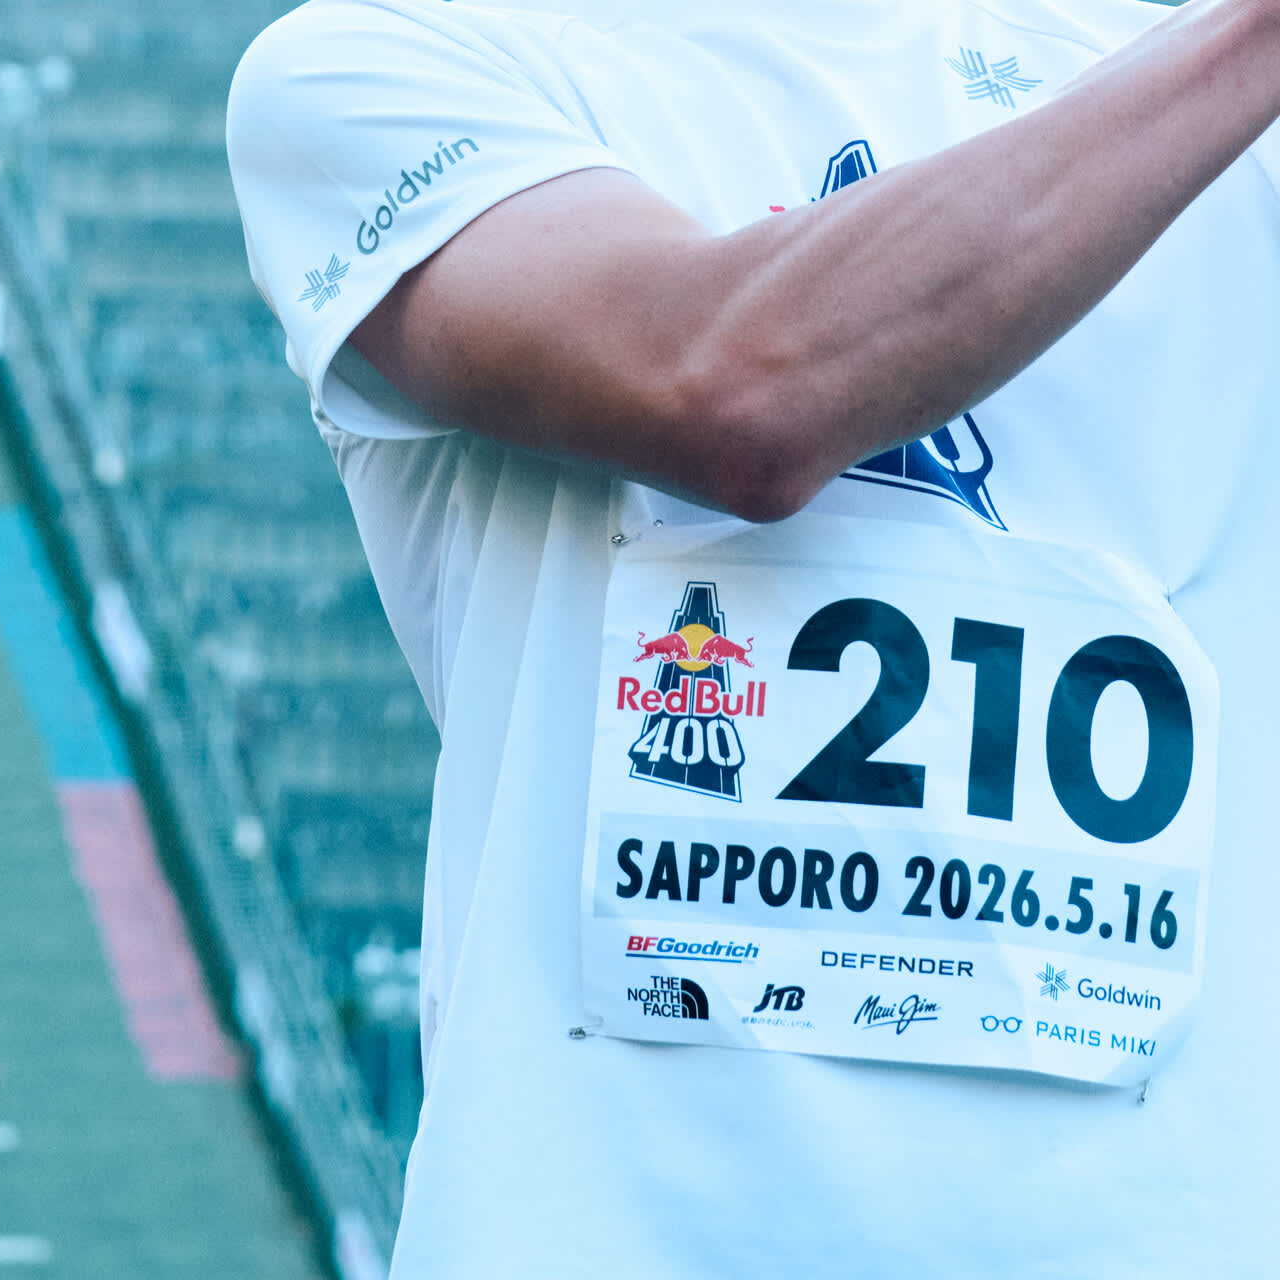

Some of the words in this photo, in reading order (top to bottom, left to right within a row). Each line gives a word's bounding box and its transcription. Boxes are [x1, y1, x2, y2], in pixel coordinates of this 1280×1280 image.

[355, 135, 480, 256] Goldwin
[616, 676, 689, 713] Red
[694, 679, 767, 717] Bull
[775, 596, 1194, 845] 210
[632, 717, 744, 767] 400
[615, 837, 880, 914] SAPPORO
[901, 854, 1179, 951] 2026.5.16
[626, 935, 760, 959] BFGoodrich
[820, 949, 974, 978] DEFENDER
[627, 988, 681, 1004] NORTH
[650, 975, 680, 991] THE
[752, 983, 806, 1014] JTB
[1077, 977, 1162, 1011] Goldwin
[643, 1002, 682, 1019] FACE
[853, 994, 897, 1025] Maui
[895, 993, 942, 1036] Jim
[1035, 1020, 1102, 1048] PARIS
[1110, 1032, 1157, 1057] MIKI
